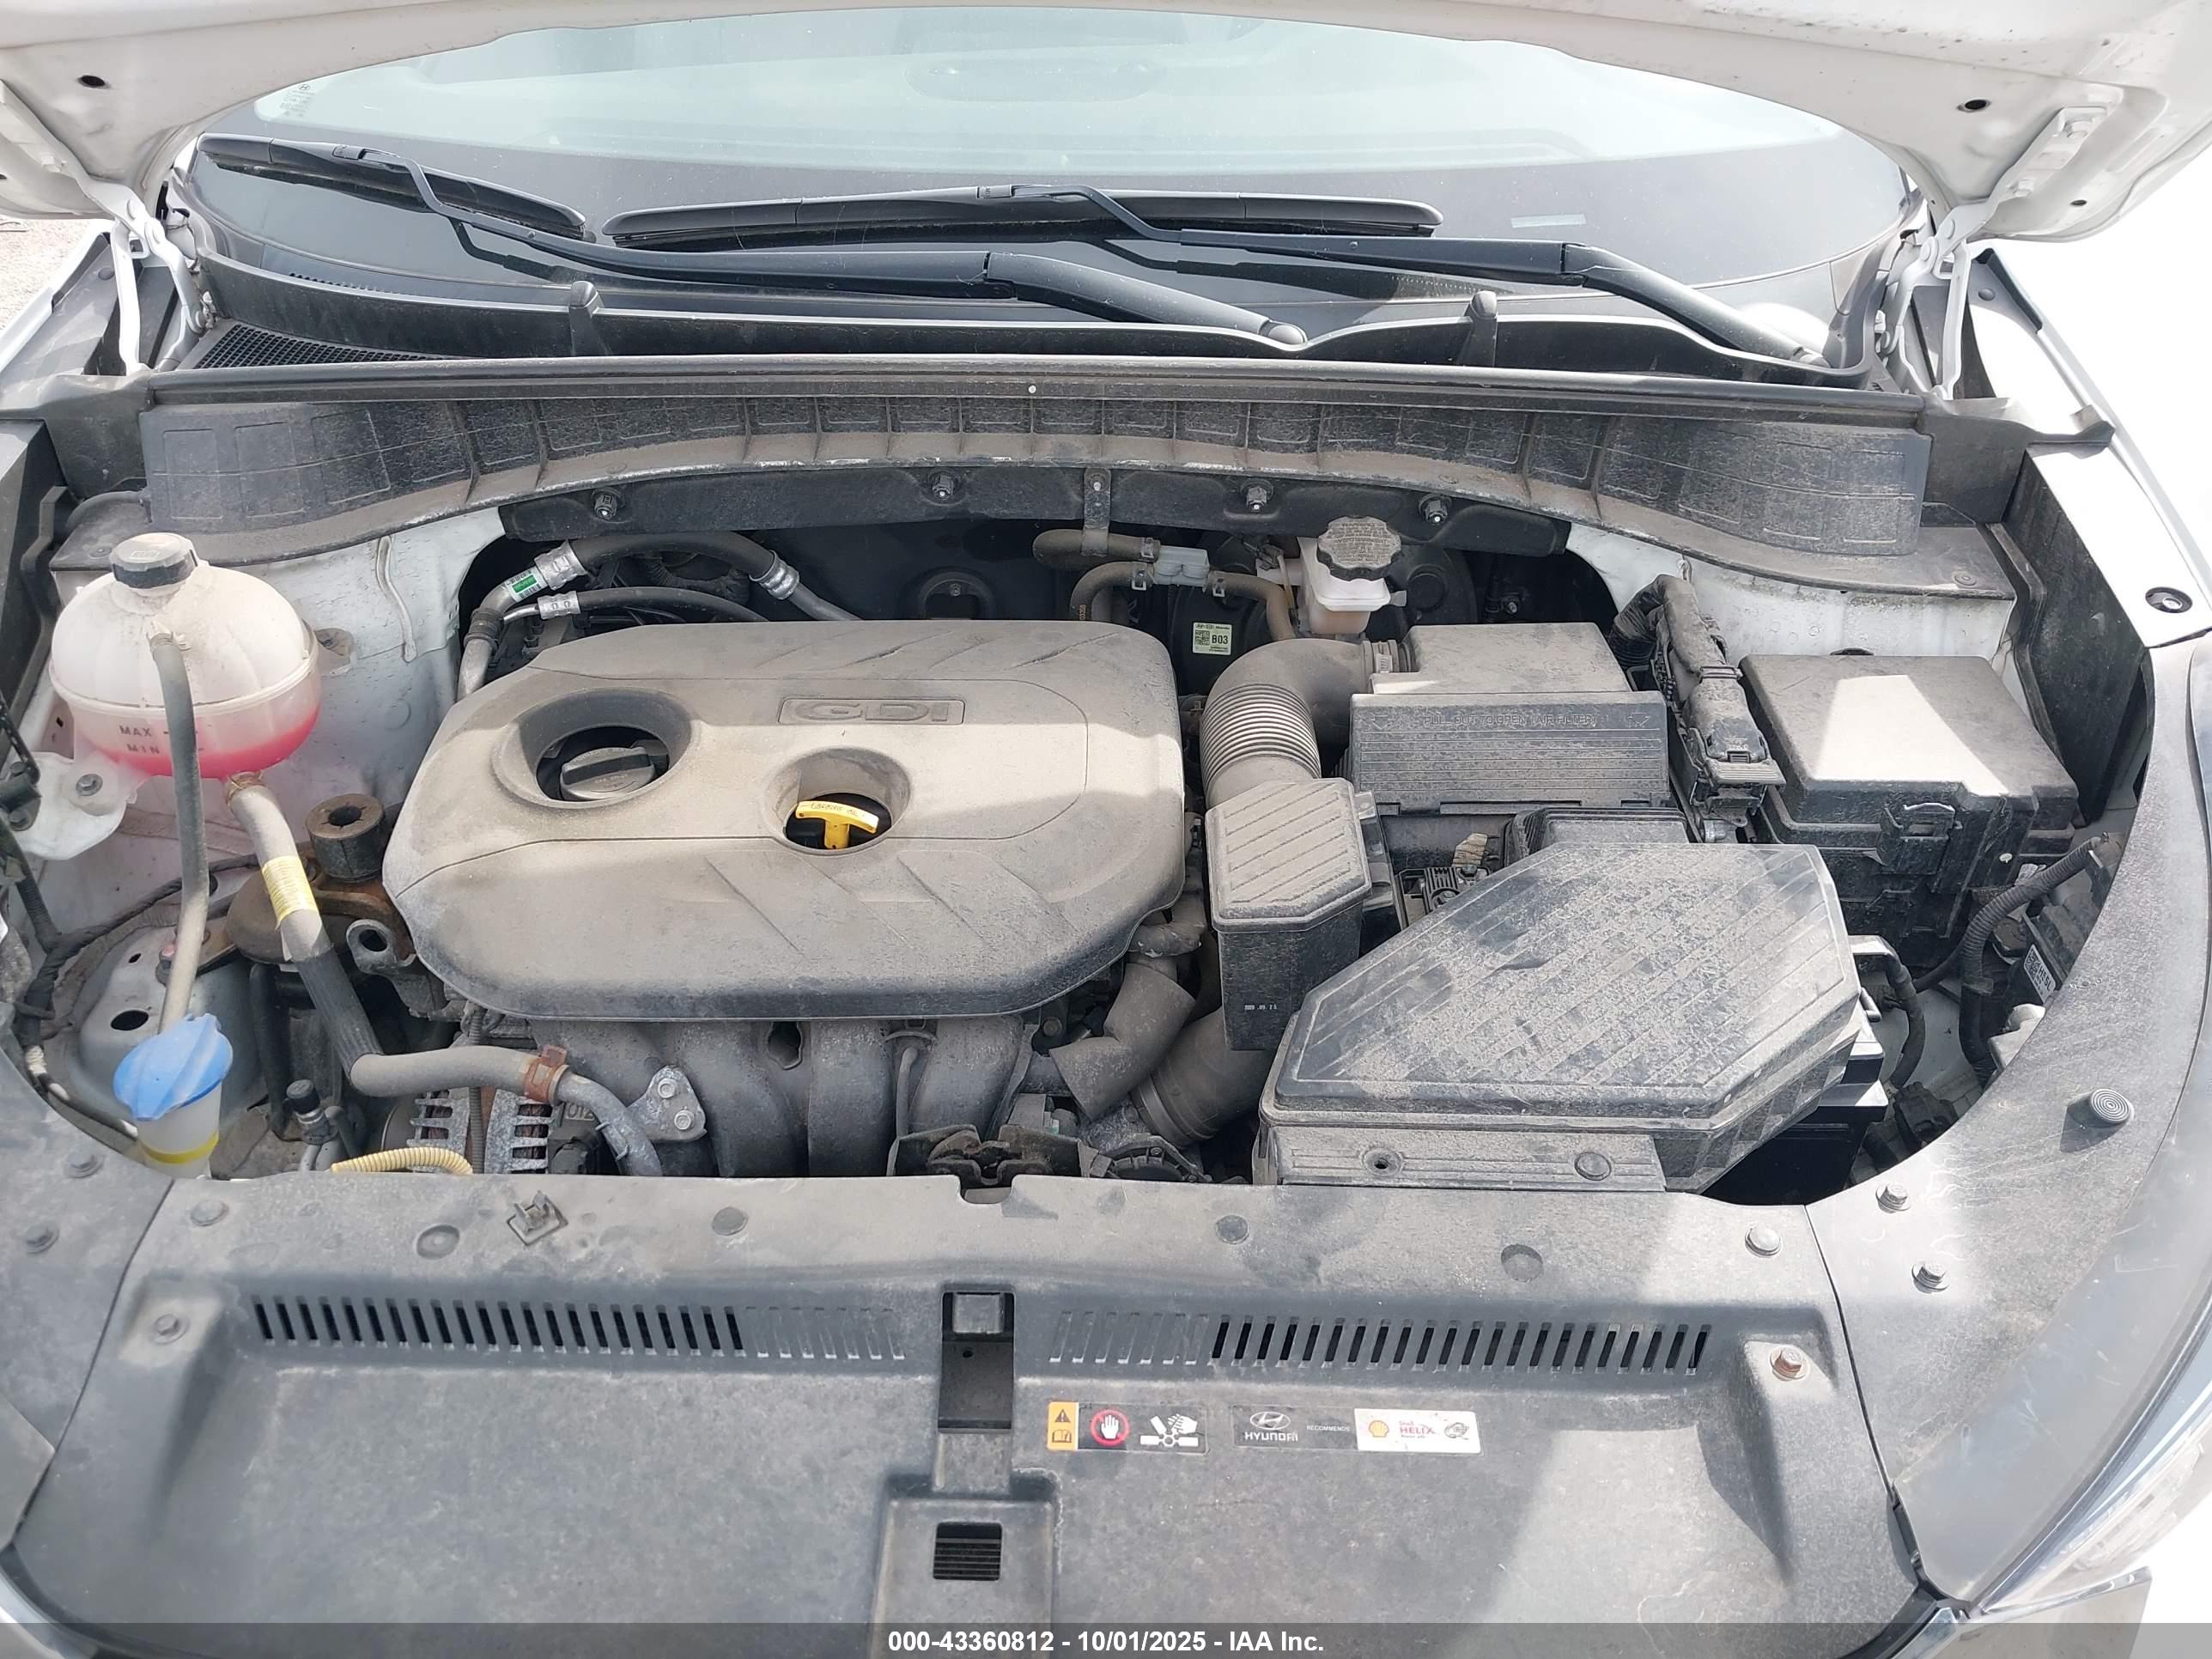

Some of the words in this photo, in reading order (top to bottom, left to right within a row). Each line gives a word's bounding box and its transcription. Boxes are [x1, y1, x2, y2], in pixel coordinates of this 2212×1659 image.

[1212, 635, 1228, 644] B03
[793, 702, 949, 722] GDI
[1496, 714, 1526, 725] OPEN
[118, 726, 152, 737] MAX
[126, 744, 161, 754] MIN
[1244, 1431, 1298, 1442] HYUNDAI
[1399, 1426, 1436, 1435] HELIX
